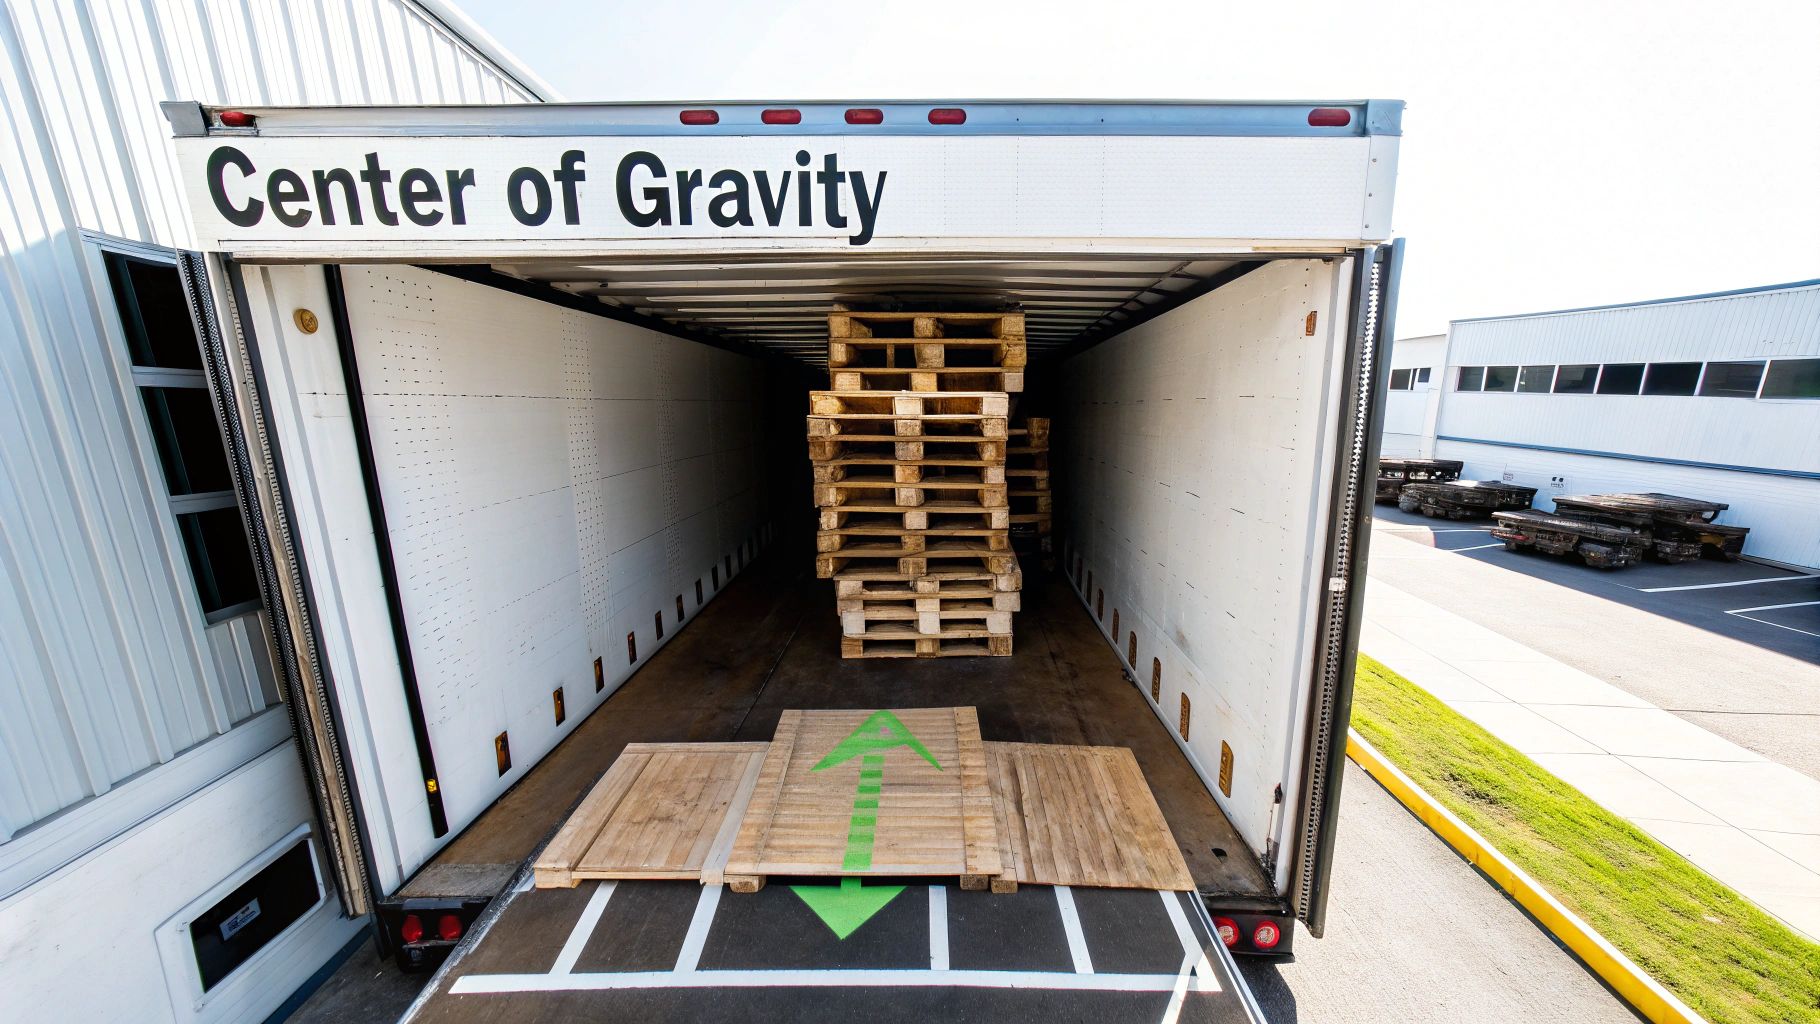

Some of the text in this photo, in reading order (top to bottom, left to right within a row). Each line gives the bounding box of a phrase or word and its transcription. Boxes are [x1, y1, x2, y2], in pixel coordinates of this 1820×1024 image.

[206, 145, 888, 246] Center of Gravity
